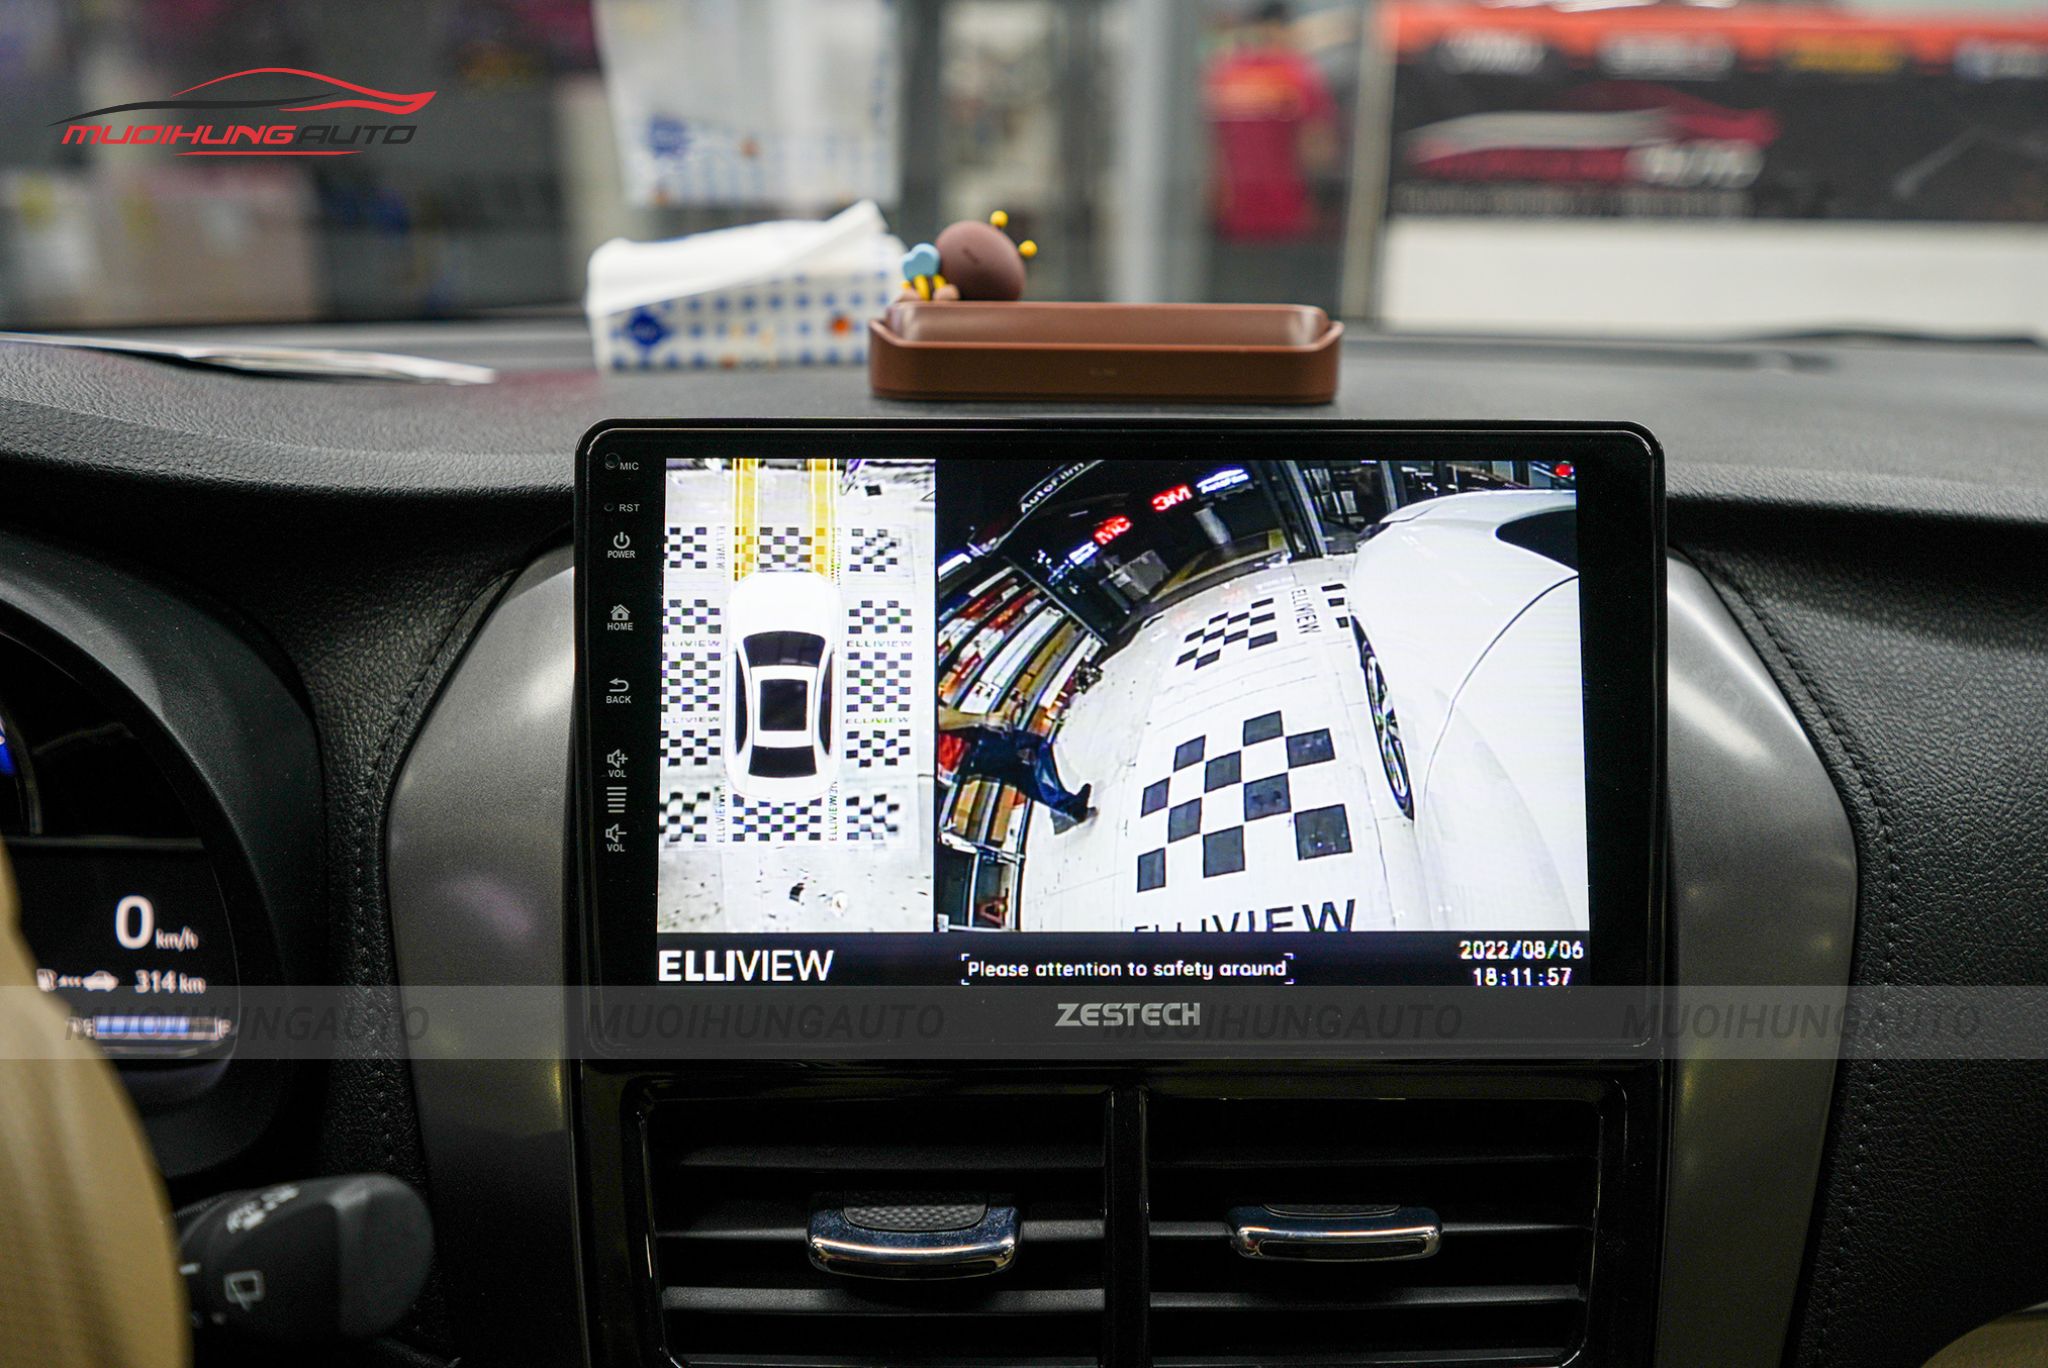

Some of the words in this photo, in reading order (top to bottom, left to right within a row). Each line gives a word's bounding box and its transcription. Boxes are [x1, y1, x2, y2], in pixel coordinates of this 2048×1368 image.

[619, 462, 640, 471] MIC
[1020, 462, 1085, 513] AutoFilm
[618, 503, 640, 513] RST
[1151, 484, 1194, 512] 3M
[607, 550, 636, 559] POWER
[606, 622, 634, 632] HOME
[605, 695, 632, 704] BACK
[608, 769, 627, 778] VOL
[606, 843, 626, 852] VOL
[115, 894, 155, 949] 0
[156, 926, 199, 951] km/h
[1458, 939, 1585, 960] 2022/08/06
[658, 950, 835, 982] ELLIVIEW
[967, 960, 1029, 978] Please
[1035, 960, 1122, 978] attention
[1127, 961, 1148, 978] to
[1153, 959, 1214, 981] safety
[1219, 960, 1287, 978] around
[135, 968, 177, 993] 314
[178, 972, 207, 994] km
[1472, 967, 1572, 986] 18:11:57
[1054, 1002, 1201, 1027] ZESTECH
